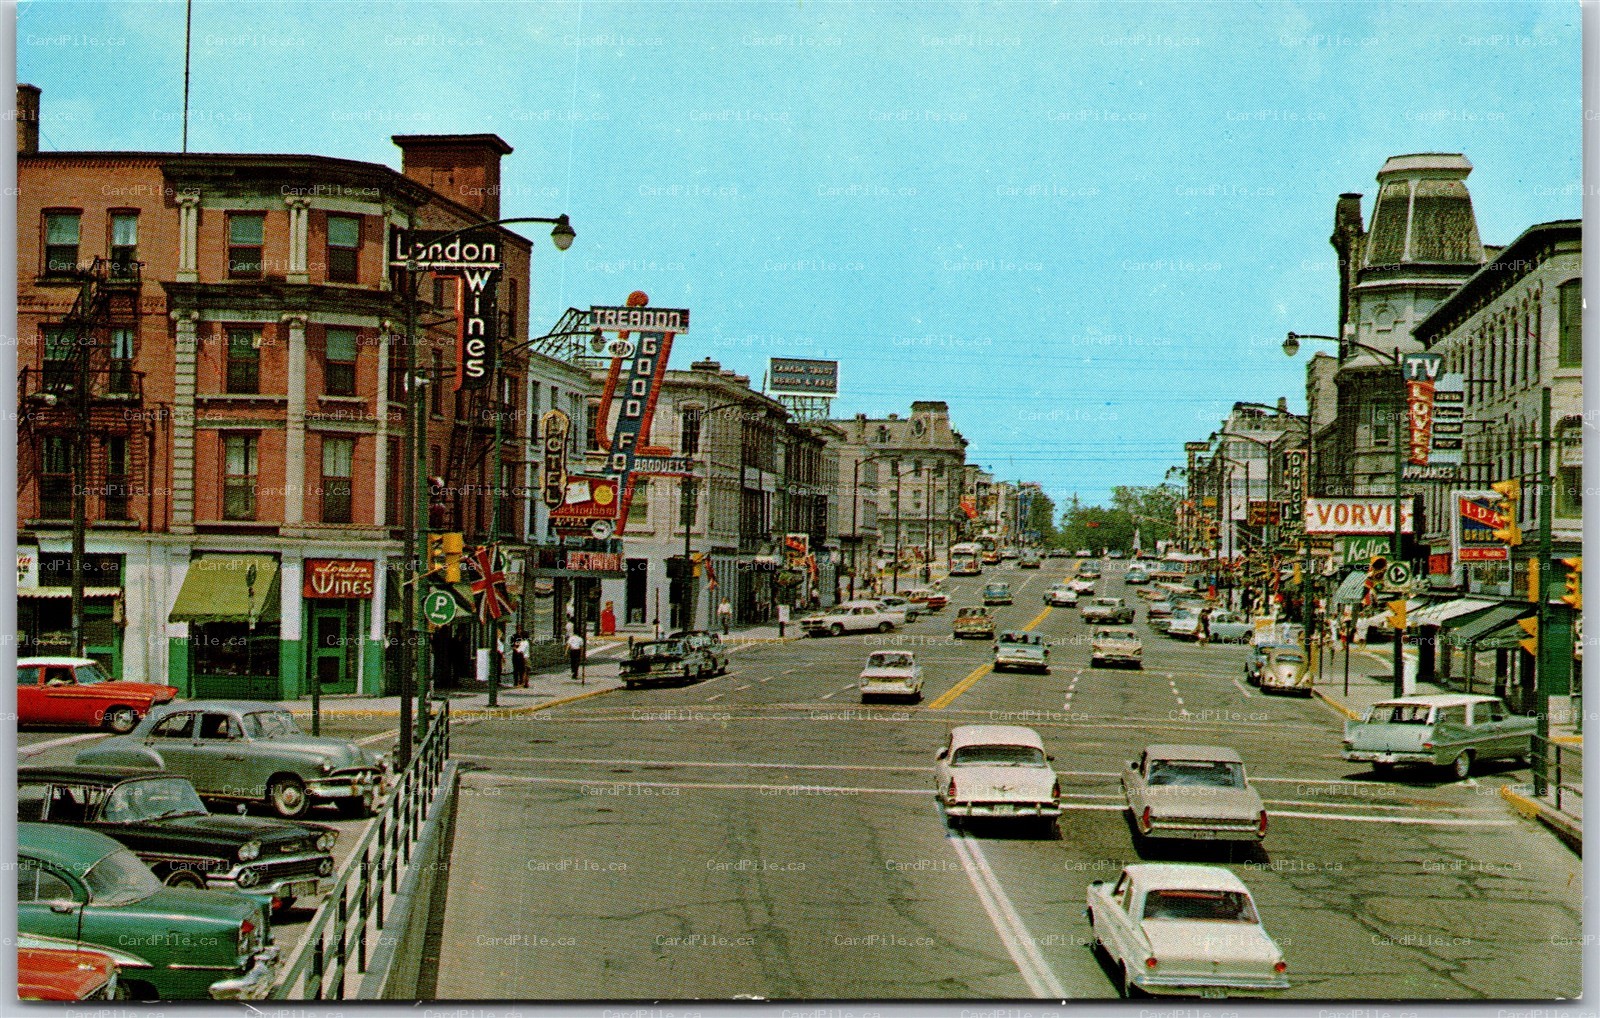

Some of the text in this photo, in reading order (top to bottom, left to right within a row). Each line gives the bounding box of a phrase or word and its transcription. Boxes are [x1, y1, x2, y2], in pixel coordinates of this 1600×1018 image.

[397, 233, 496, 261] London
[464, 270, 492, 377] Wines
[626, 337, 657, 417] GOOD
[1407, 357, 1442, 378] TV
[1292, 454, 1301, 515] DRUGS
[434, 595, 448, 612] P
